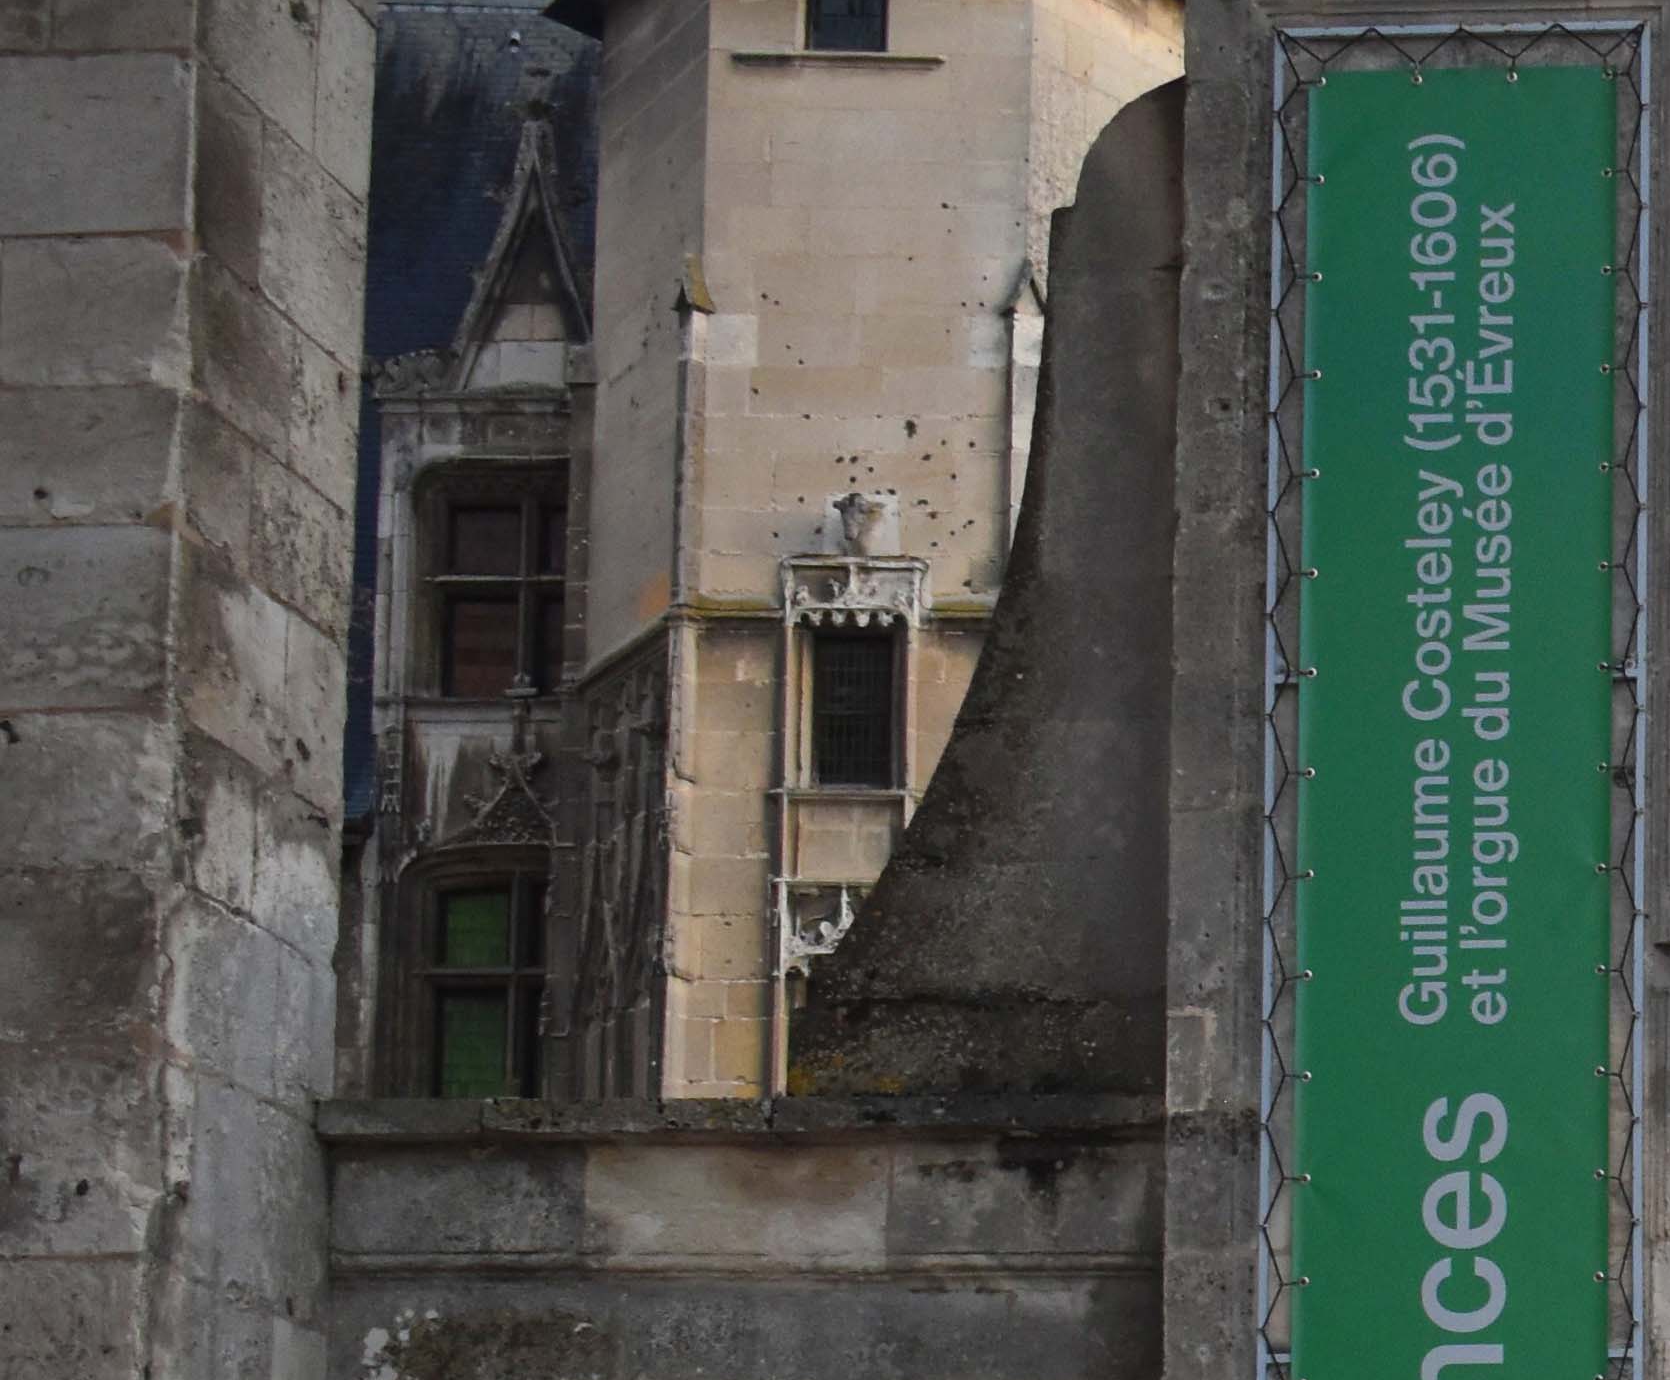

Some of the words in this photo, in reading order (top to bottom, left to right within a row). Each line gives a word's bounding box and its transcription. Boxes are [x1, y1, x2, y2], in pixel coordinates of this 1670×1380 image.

[1403, 133, 1467, 452] (1531-1606)
[1402, 468, 1464, 722] Costeley
[1460, 463, 1513, 652] Musée
[1461, 671, 1511, 741] du
[1399, 737, 1451, 1025] Guillaume
[1459, 758, 1520, 950] l'orgue
[1460, 968, 1508, 1025] et
